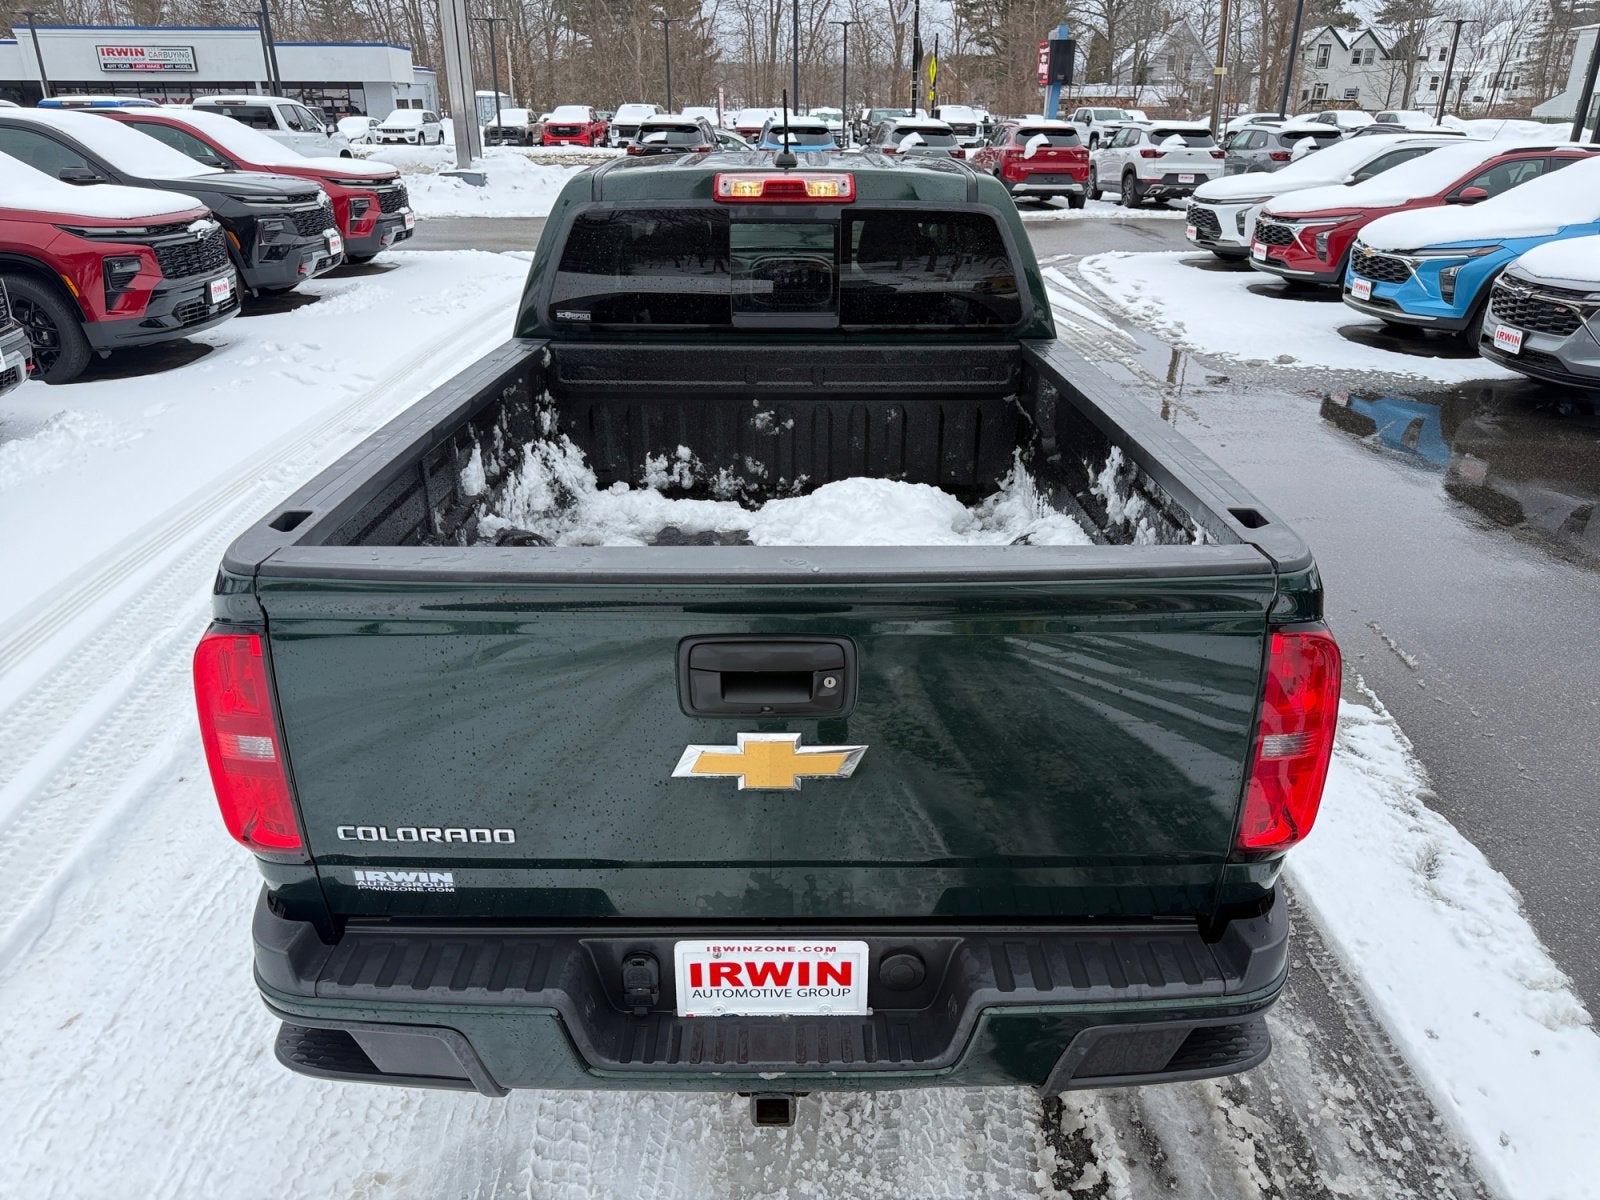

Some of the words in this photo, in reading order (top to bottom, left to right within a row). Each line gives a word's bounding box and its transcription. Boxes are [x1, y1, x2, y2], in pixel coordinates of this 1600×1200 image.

[100, 47, 145, 56] IRWIN
[1496, 330, 1520, 345] IRWIN
[336, 825, 517, 844] COLORADO
[354, 870, 454, 882] IRWIN
[690, 961, 852, 988] IRWIN
[692, 988, 793, 999] AUTOMOTIVE
[796, 988, 851, 998] GROUP
